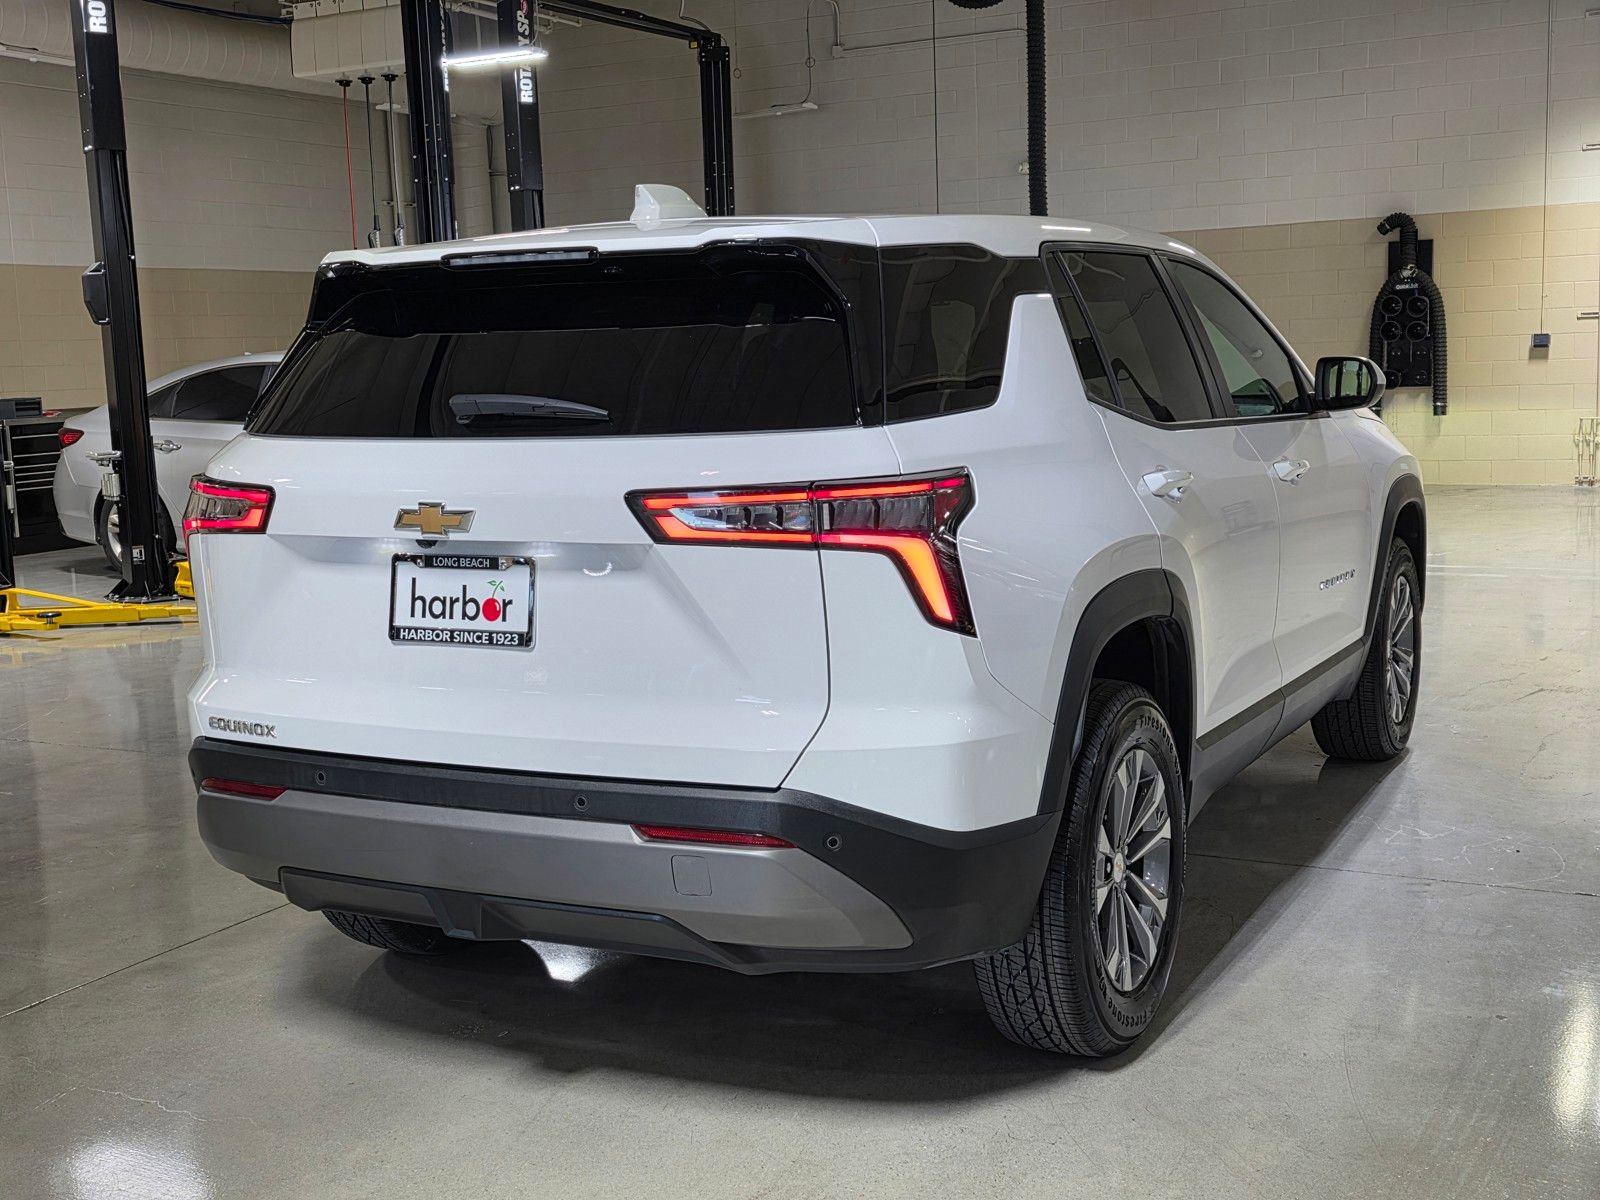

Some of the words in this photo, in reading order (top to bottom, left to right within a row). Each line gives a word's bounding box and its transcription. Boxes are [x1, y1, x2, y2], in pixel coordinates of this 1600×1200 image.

[87, 0, 108, 33] RO
[518, 35, 533, 103] ROTY
[433, 557, 458, 567] LONG
[460, 558, 490, 568] BEACH
[410, 577, 513, 622] harbor
[400, 628, 451, 642] HARBOR
[453, 631, 489, 644] SINCE
[491, 633, 519, 645] 1923
[208, 716, 277, 738] EQUINOX
[1139, 714, 1174, 754] Firestone
[1108, 997, 1148, 1027] Firestone
